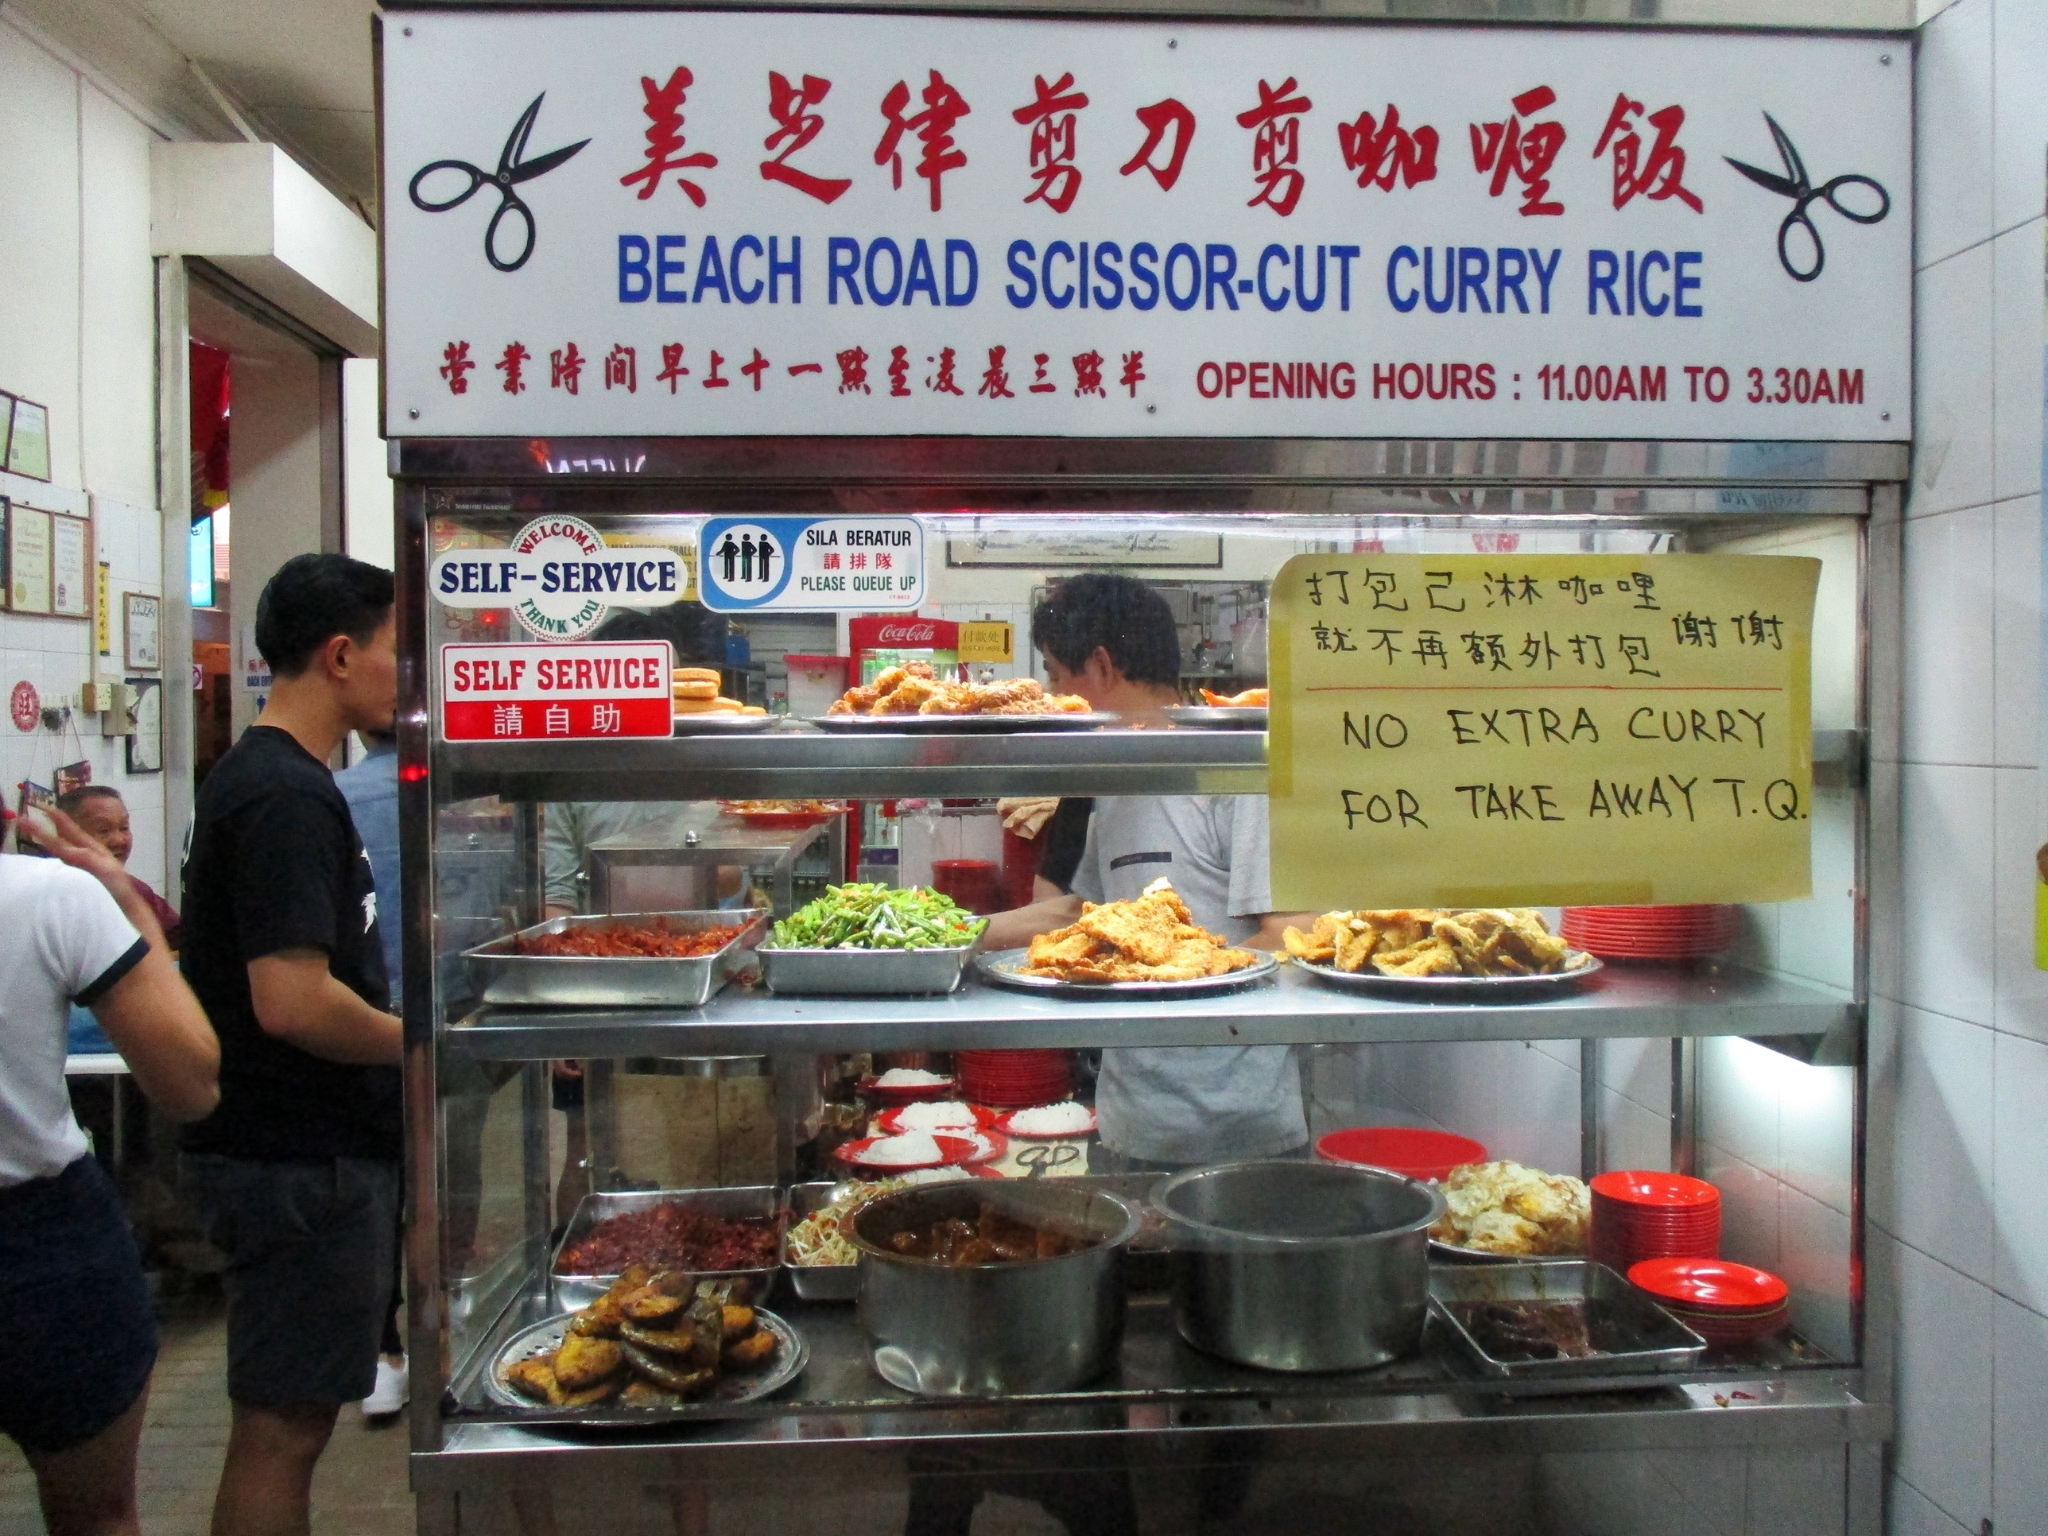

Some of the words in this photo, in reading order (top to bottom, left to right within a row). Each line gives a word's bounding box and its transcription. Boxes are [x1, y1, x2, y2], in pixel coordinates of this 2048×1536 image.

[619, 235, 800, 303] BEACH
[829, 237, 978, 306] ROAD
[1007, 240, 1360, 311] SCISSOR-CUT
[1388, 245, 1561, 312] CURRY
[1590, 250, 1703, 316] RICE
[1198, 362, 1354, 398] OPENING
[1375, 364, 1494, 399] HOURS
[1539, 367, 1664, 400] 11.00AM
[1685, 367, 1727, 402] TO
[1749, 369, 1861, 402] 3.30AM
[518, 522, 597, 556] WELCOME
[806, 529, 838, 546] SILA
[847, 530, 911, 546] BERATUR
[440, 561, 676, 593] SELF-SERVICE
[823, 552, 892, 570] 請排隊
[801, 576, 846, 591] PLEASE
[853, 576, 893, 591] QUEUE
[900, 576, 916, 590] UP
[521, 598, 568, 633] THANK
[571, 599, 600, 628] YOU
[454, 660, 526, 692] SELF
[537, 657, 660, 691] SERVICE
[493, 702, 621, 736] 請自助
[1344, 712, 1408, 749] NO
[1446, 708, 1600, 747] EXTRA
[1628, 707, 1766, 749] CURRY
[1342, 790, 1428, 829] FOR
[1455, 783, 1564, 821] TAKE
[1589, 775, 1697, 822] AWAY
